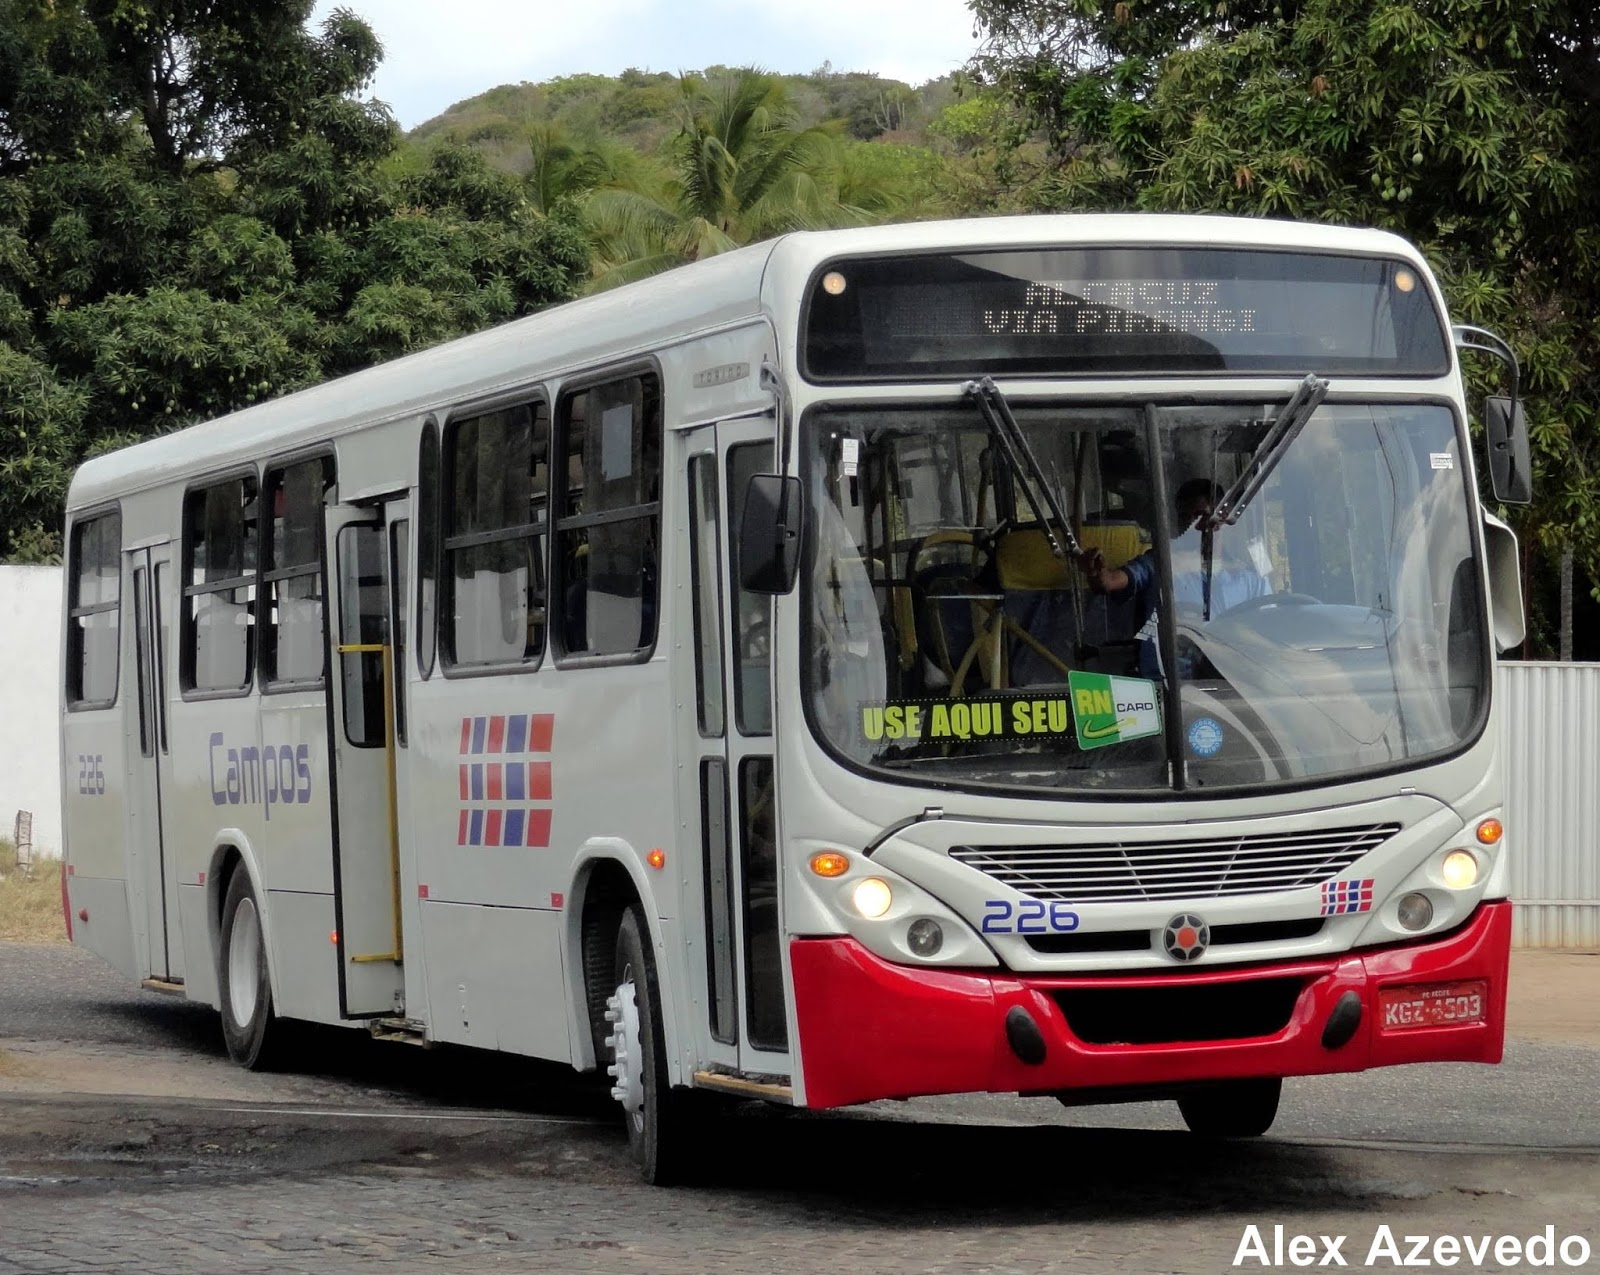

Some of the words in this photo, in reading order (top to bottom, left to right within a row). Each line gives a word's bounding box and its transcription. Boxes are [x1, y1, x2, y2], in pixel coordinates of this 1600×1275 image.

[984, 310, 1057, 333] VIA
[1077, 310, 1256, 332] PIRANGI
[863, 705, 922, 740] USE
[930, 703, 1004, 739] AQUI
[1012, 699, 1067, 733] SEU
[1075, 688, 1113, 716] RN
[1116, 702, 1154, 713] CARD
[79, 754, 105, 795] 226
[209, 731, 312, 822] Campos
[982, 901, 1080, 933] 226
